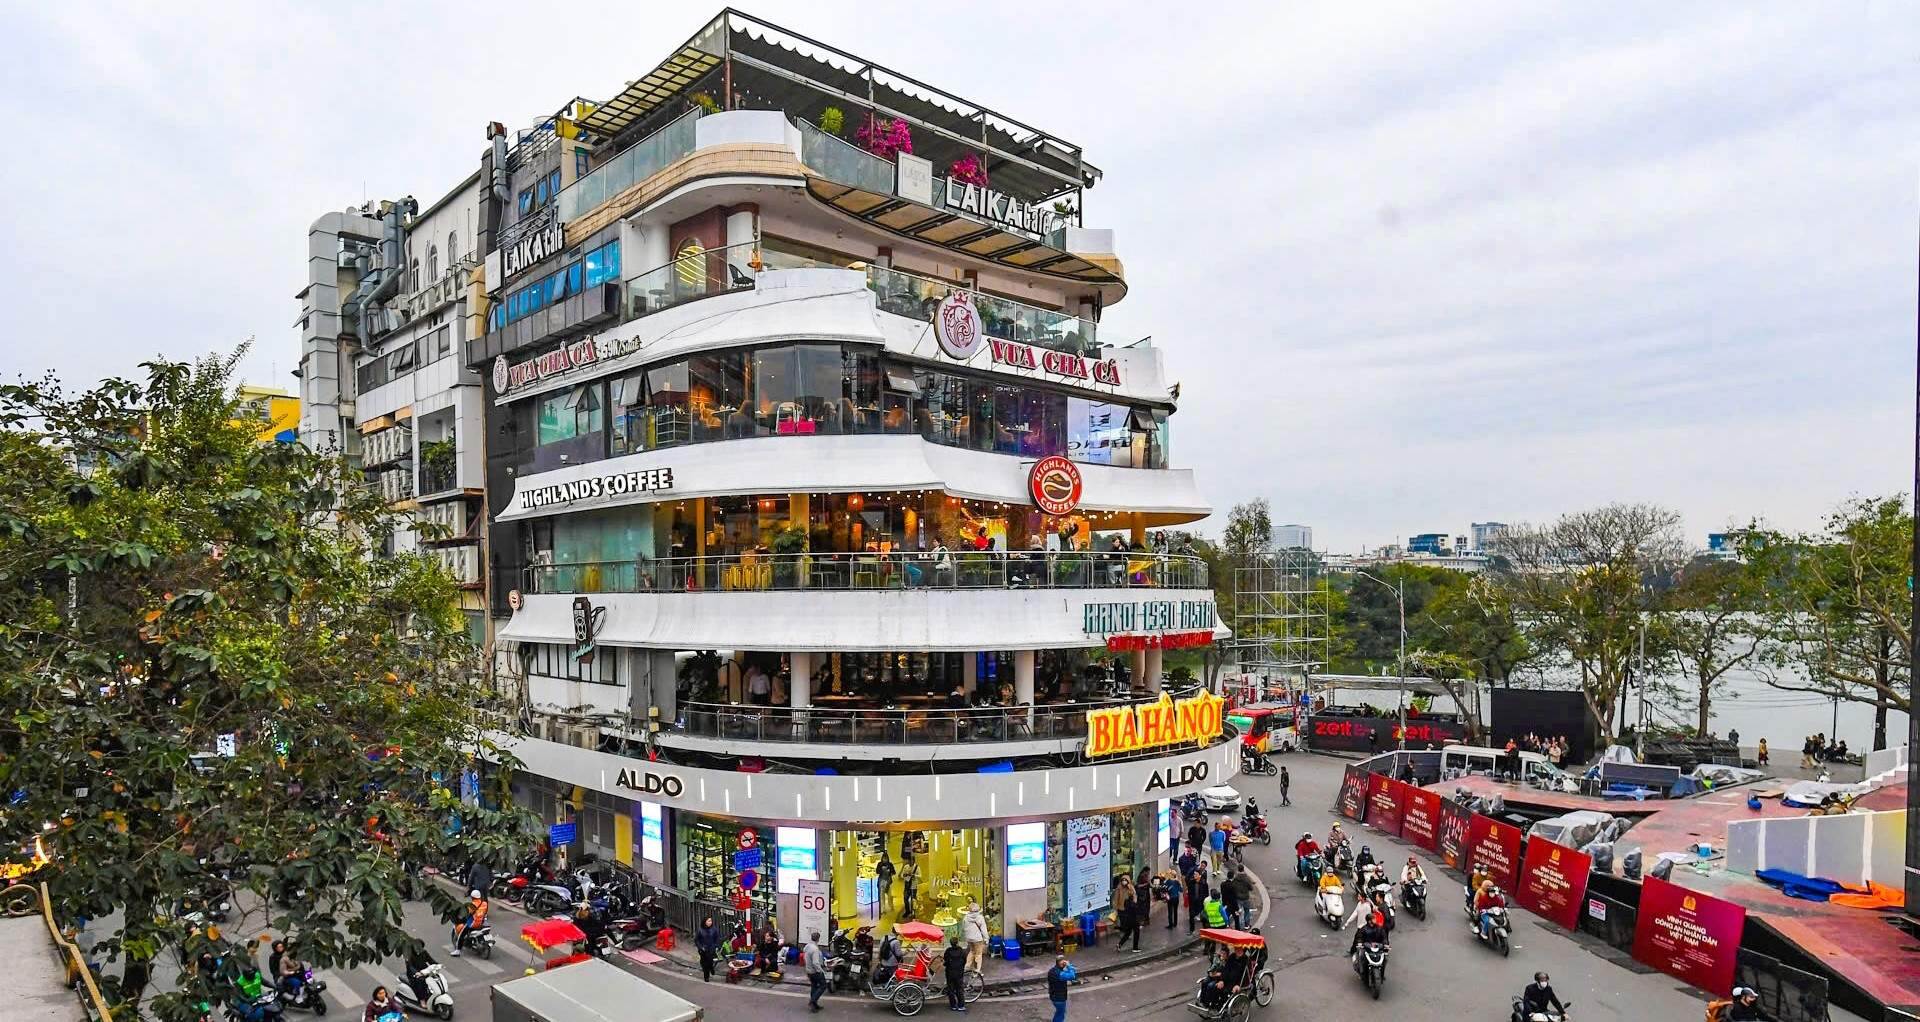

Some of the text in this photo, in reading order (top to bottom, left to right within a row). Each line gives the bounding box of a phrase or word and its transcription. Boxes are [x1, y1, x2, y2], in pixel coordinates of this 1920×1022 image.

[946, 176, 1022, 228] LAIKA
[504, 222, 564, 278] LAIKA Café
[509, 359, 537, 386] VUA
[536, 341, 570, 379] CHẢ
[988, 338, 1121, 386] VUA CHẢ CÁ
[520, 468, 672, 508] HIGHLANDS COFFEE
[1035, 460, 1080, 485] HIGHLANDS
[1040, 497, 1075, 512] COFFEE
[1084, 600, 1217, 633] HANOI 1930 BISTRO
[1087, 688, 1224, 757] BIA HÀ NỘI
[616, 767, 684, 797] ALDO
[1145, 761, 1208, 791] ALDO
[1076, 833, 1102, 860] 50
[803, 895, 825, 911] 50
